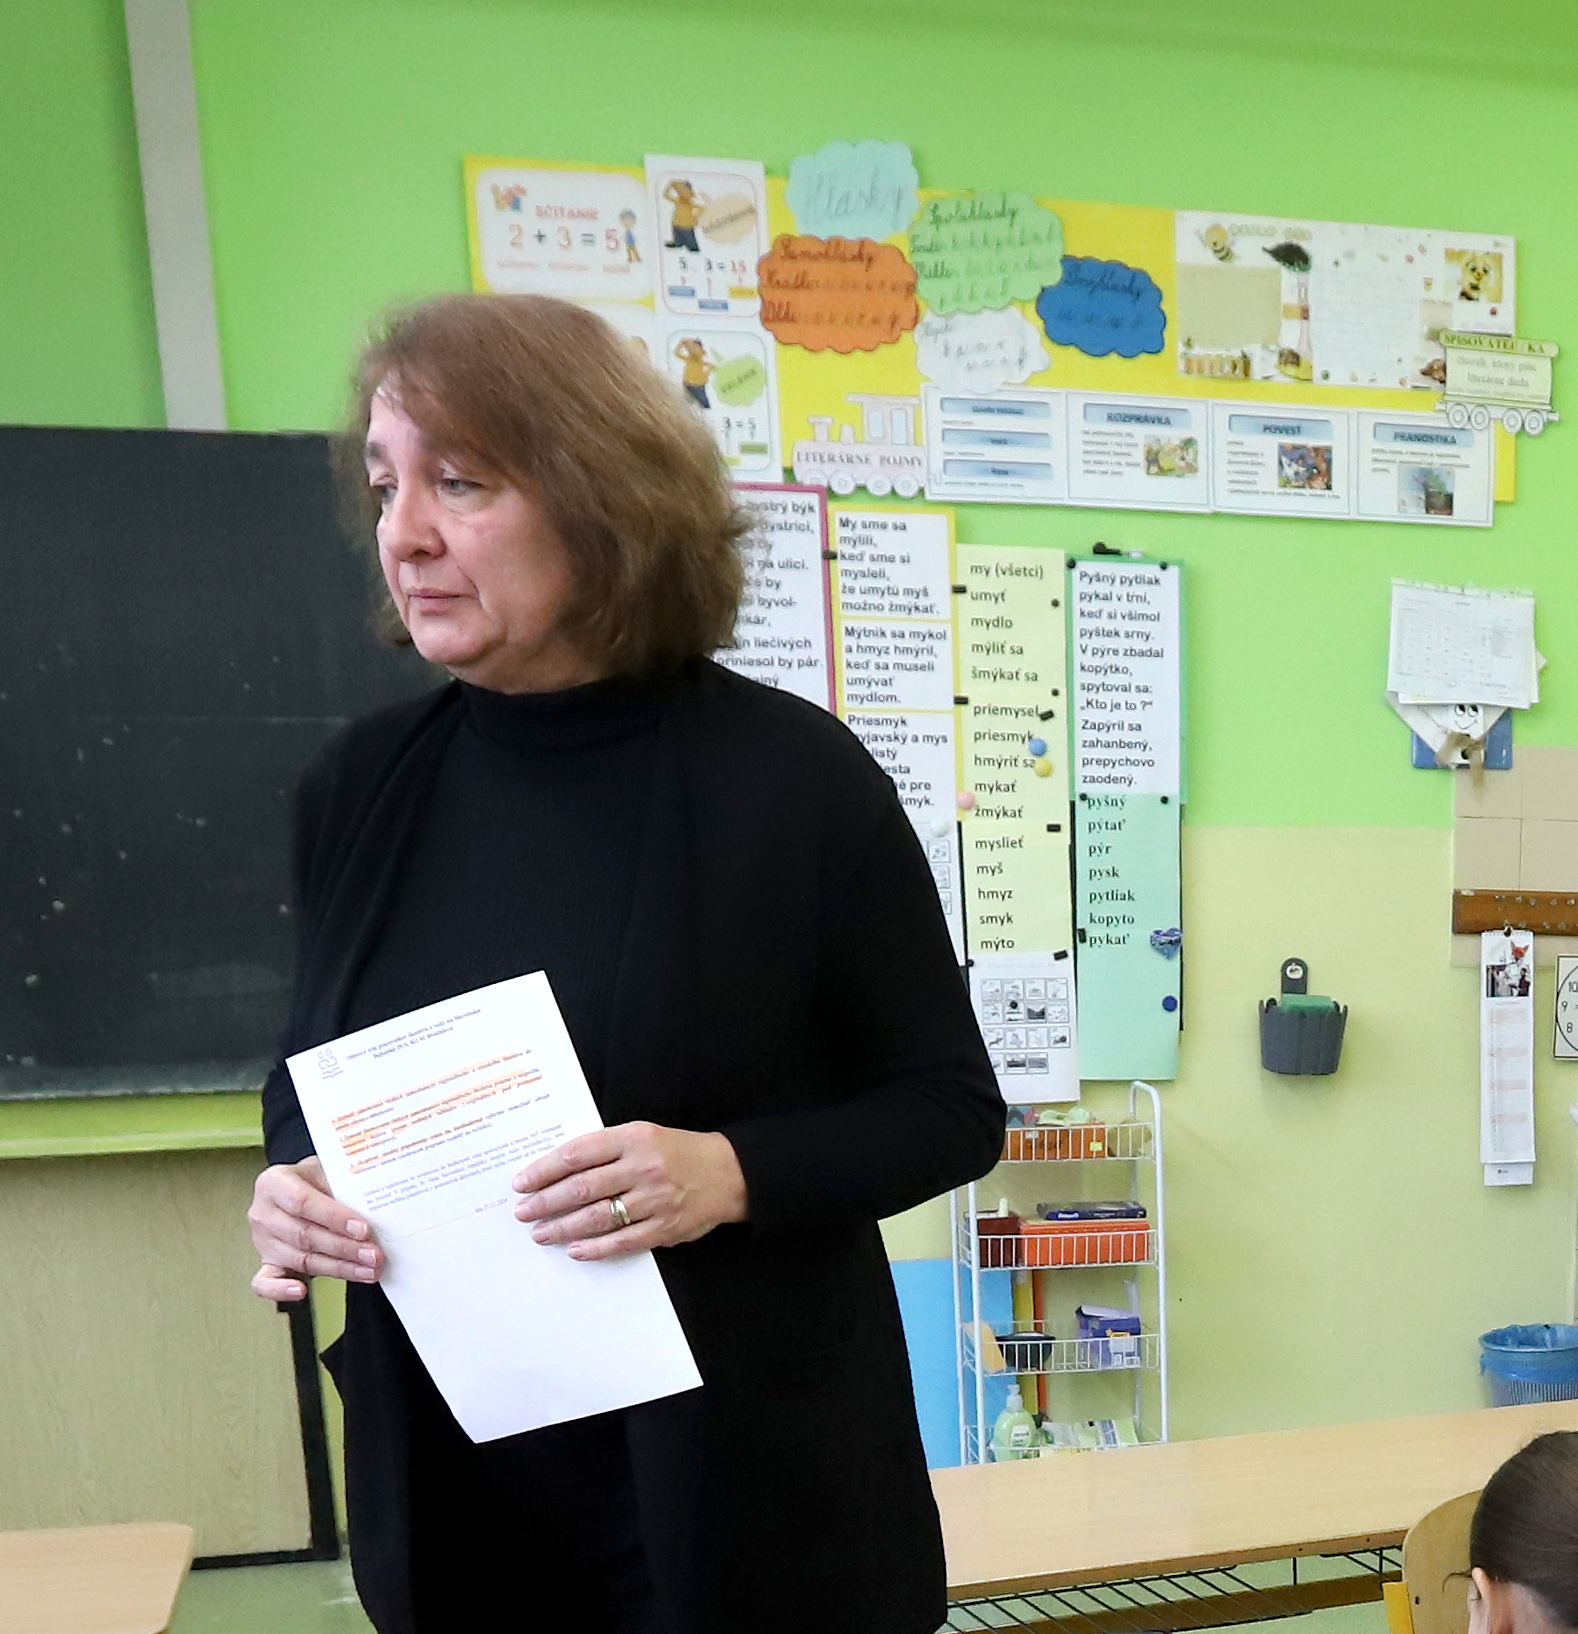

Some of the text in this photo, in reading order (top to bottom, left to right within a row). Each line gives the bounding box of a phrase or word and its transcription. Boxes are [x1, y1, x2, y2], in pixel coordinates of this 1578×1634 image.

[839, 516, 907, 532] My sme sa
[869, 554, 896, 563] sme
[899, 552, 910, 564] si
[970, 562, 1043, 580] my (všetci)
[1079, 571, 1161, 586] Pyšný pytliak
[841, 582, 855, 594] že
[902, 586, 929, 600] myš
[971, 589, 1006, 604] umyť
[1079, 590, 1112, 602] pykal
[841, 600, 885, 611] možno
[1107, 609, 1116, 619] si
[1120, 611, 1160, 621] všimol
[971, 616, 1013, 630] mydlo
[890, 629, 905, 638] sa
[909, 629, 947, 642] mykol
[845, 645, 853, 653] a
[856, 643, 890, 657] hmyz
[971, 642, 1023, 656] mýliť sa
[1080, 644, 1087, 654] V
[1123, 647, 1164, 658] zbadal
[874, 661, 889, 671] sa
[893, 661, 935, 671] museli
[971, 667, 1039, 682] šmýkať sa
[1080, 682, 1131, 693] spytoval
[974, 705, 1039, 718] priemysel
[1109, 699, 1121, 712] je
[1125, 700, 1137, 710] to
[848, 714, 908, 728] Priesmyk
[1127, 723, 1141, 731] sa
[911, 733, 948, 745] a mys
[974, 730, 1034, 744] priesmyk
[974, 754, 1020, 769] hmýriť
[1082, 756, 1155, 768] prepychovo
[910, 783, 932, 796] pre
[974, 780, 1017, 794] mykať
[1087, 795, 1126, 810] pyšný
[974, 806, 1024, 820] žmýkať
[975, 836, 1024, 850] myslieť
[1089, 842, 1112, 857] pýr
[977, 862, 1003, 876] myš
[1089, 866, 1120, 880] pysk
[978, 888, 1013, 901] hmyz
[1089, 890, 1135, 904] pytliak
[980, 912, 1014, 926] smyk
[1089, 912, 1134, 927] kopyto
[981, 937, 1015, 951] mýto
